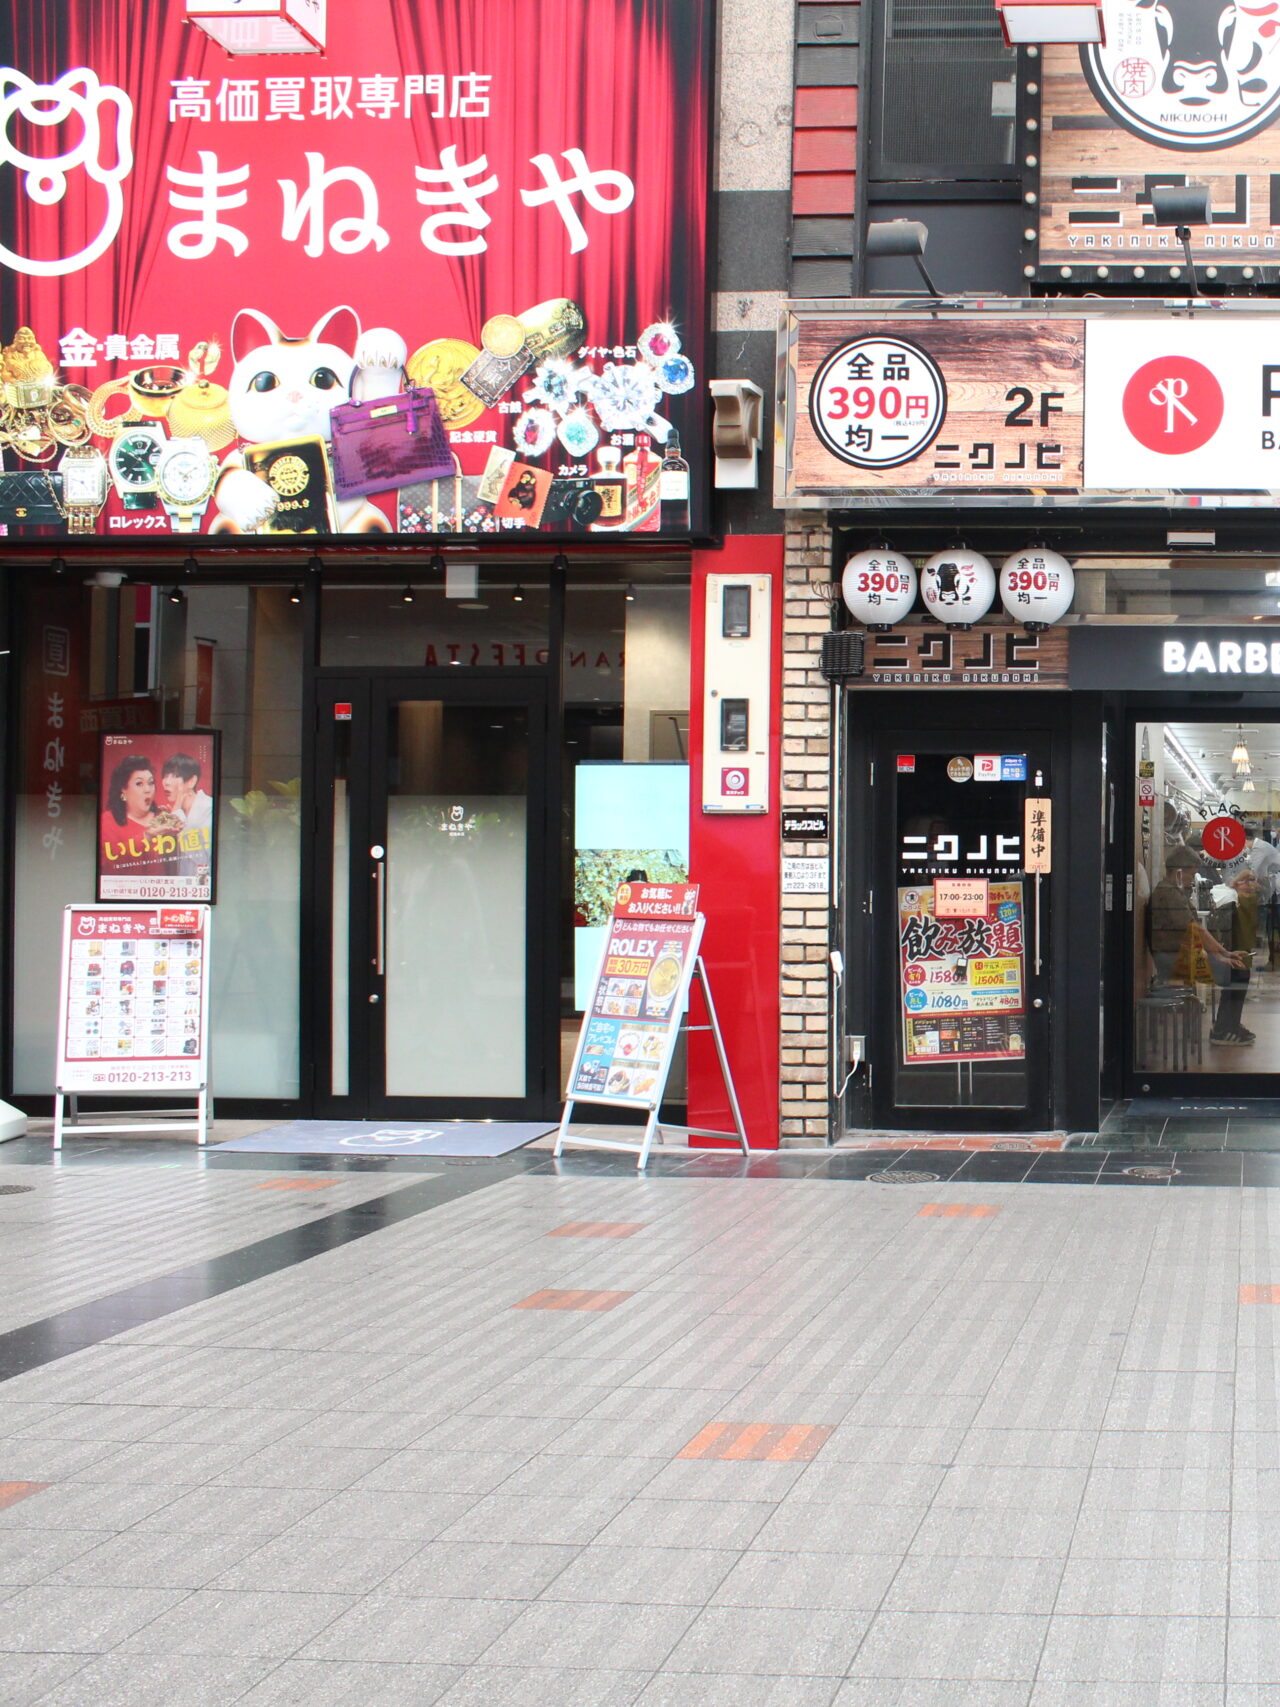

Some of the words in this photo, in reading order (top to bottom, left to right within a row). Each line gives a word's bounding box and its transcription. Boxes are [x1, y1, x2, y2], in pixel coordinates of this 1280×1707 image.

[1121, 58, 1147, 96] 焼肉
[168, 73, 492, 123] 高価買取専門店
[1160, 114, 1228, 122] NIKUNOHI
[166, 144, 635, 260] まねきや
[59, 328, 180, 366] 金・貴金属
[578, 346, 637, 358] ダイヤ・色石
[847, 353, 909, 381] 全品
[827, 386, 929, 420] 390円
[1004, 387, 1064, 427] 2F
[450, 431, 497, 443] 記念硬貨
[610, 434, 635, 445] お酒
[845, 424, 909, 452] 均一
[558, 464, 588, 476] カメラ
[109, 516, 167, 529] ロレックス
[502, 517, 525, 529] 切手
[868, 559, 899, 572] 全品
[1017, 557, 1047, 570] 全品
[868, 593, 899, 606] 均一
[1017, 592, 1047, 605] 均一
[1200, 802, 1248, 823] PLAGE
[1030, 810, 1048, 859] 準備中
[140, 887, 210, 898] 0120-213-213
[939, 893, 984, 902] 17:00-23:00
[98, 923, 145, 935] まねきや
[902, 916, 1024, 962] 飲み放題
[608, 938, 659, 958] ROLEX
[108, 1070, 192, 1083] 0120-213-213
